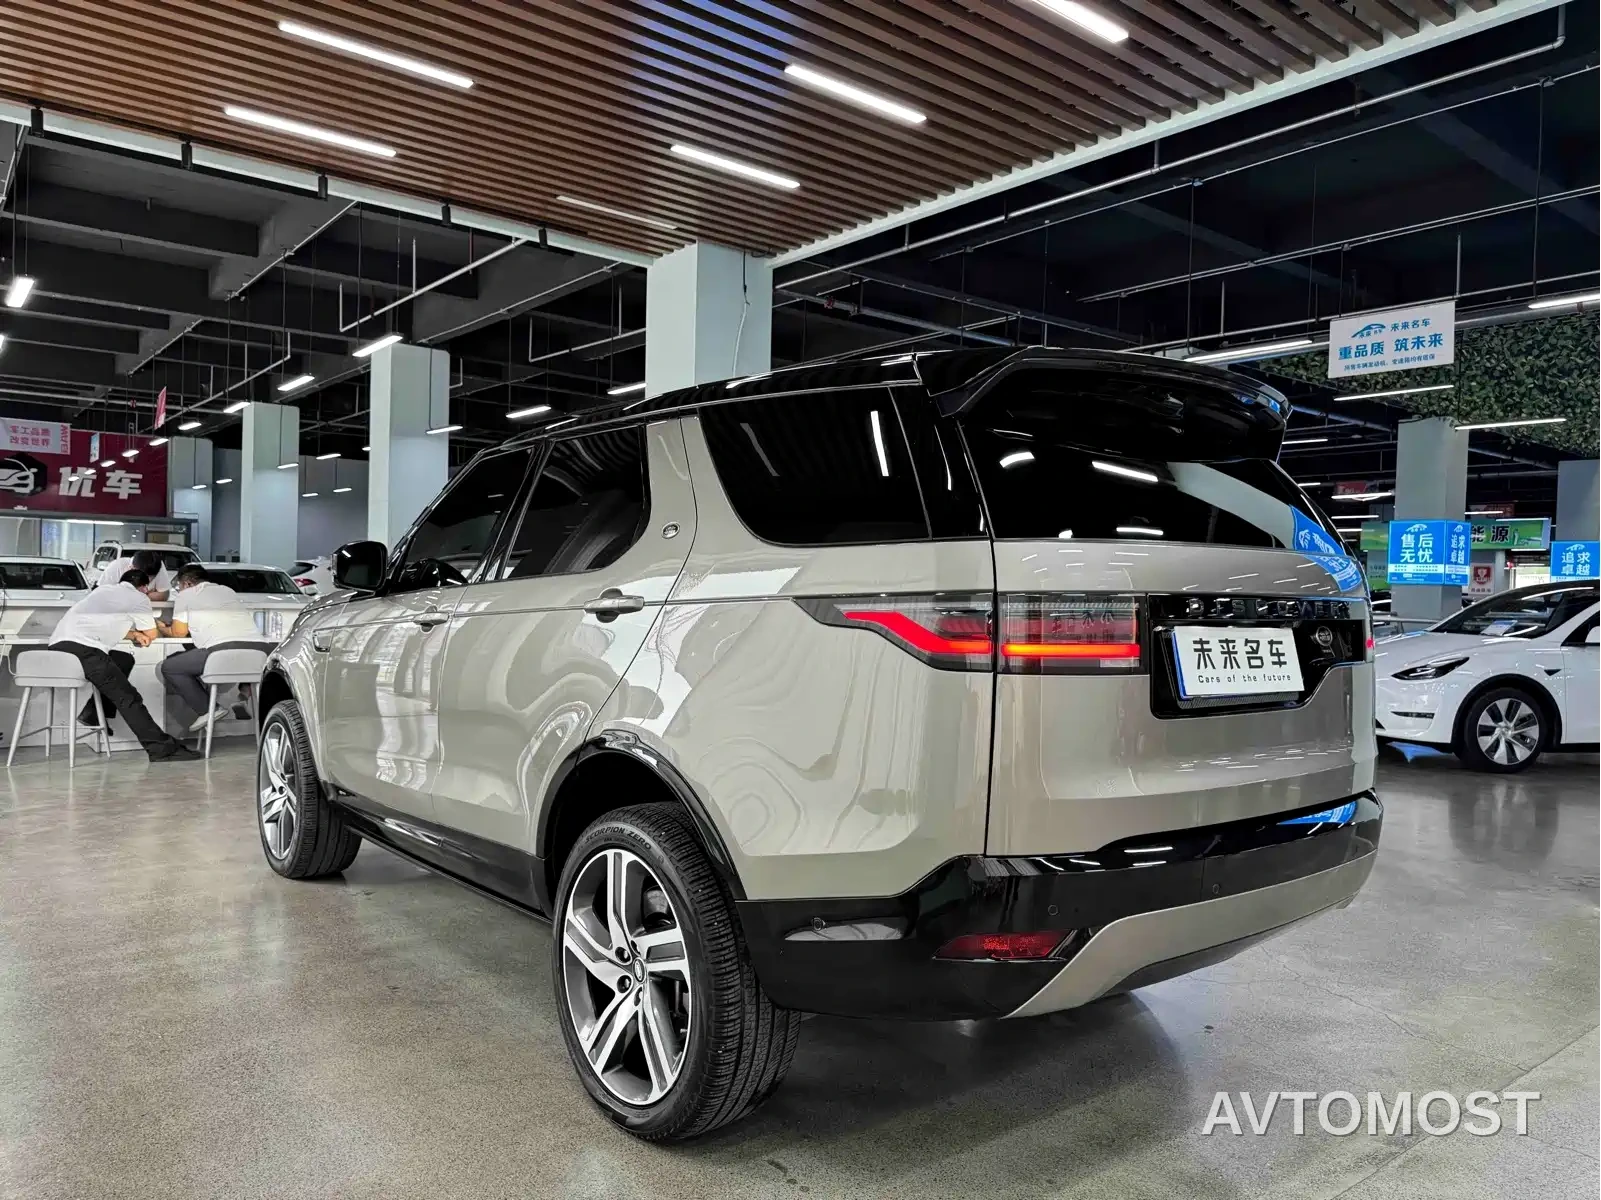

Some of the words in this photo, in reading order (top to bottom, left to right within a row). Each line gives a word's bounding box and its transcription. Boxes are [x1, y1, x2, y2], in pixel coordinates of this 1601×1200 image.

[1390, 318, 1431, 332] 未来名车
[1338, 341, 1385, 360] 重品质
[1394, 333, 1443, 352] 筑未来
[58, 466, 143, 500] 优车
[1401, 533, 1434, 548] 售后
[1451, 534, 1465, 549] 追求
[1400, 548, 1433, 563] 无忧
[1450, 549, 1465, 564] 卓越
[1561, 552, 1591, 564] 追求
[1561, 564, 1591, 576] 卓越
[1192, 638, 1287, 670] 未来名车
[1198, 675, 1221, 684] Cars
[1227, 674, 1237, 683] of
[1242, 674, 1257, 682] the
[1263, 673, 1291, 682] future
[585, 826, 625, 844] SCORPION
[627, 831, 652, 850] ZERO
